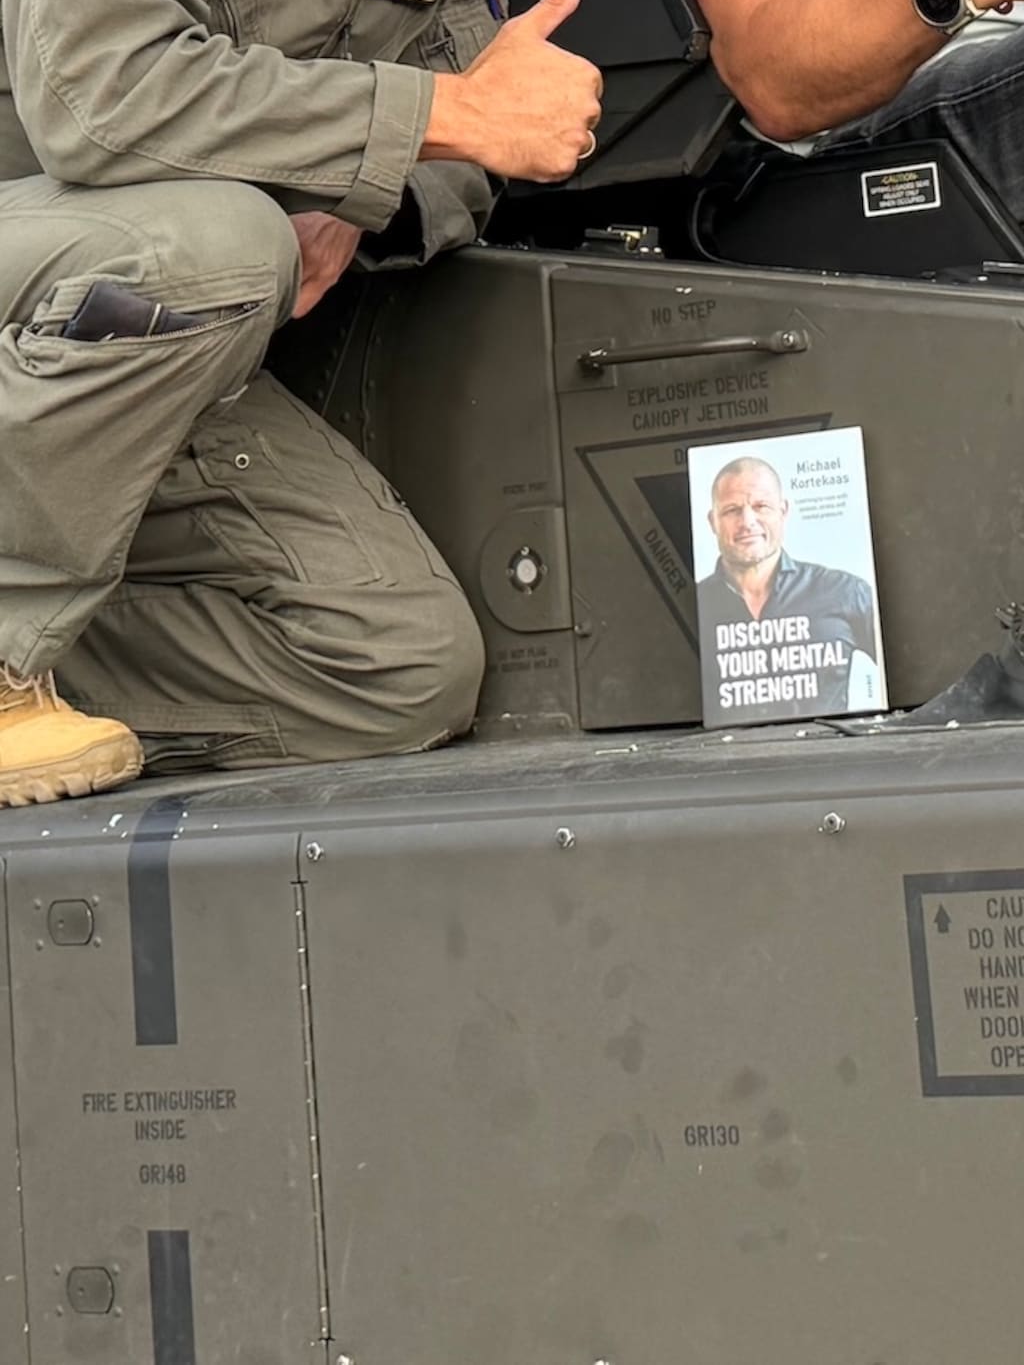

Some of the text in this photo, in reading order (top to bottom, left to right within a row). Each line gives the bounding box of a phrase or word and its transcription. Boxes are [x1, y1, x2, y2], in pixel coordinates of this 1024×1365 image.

[651, 299, 716, 325] NO STEP
[627, 371, 769, 407] EXPLOSIVE DEVICE
[633, 397, 768, 431] CANOPY JETTISON
[797, 457, 841, 474] Michael
[790, 474, 849, 490] Kortekaas
[645, 529, 687, 595] DANGER
[716, 616, 810, 650] DISCOVER
[716, 640, 849, 679] YOUR MENTAL
[719, 672, 818, 708] STRENGTH
[968, 928, 994, 950] DO
[964, 986, 1019, 1010] WHEN
[82, 1089, 237, 1113] FIRE EXTINGUISHER
[135, 1119, 186, 1140] INSIDE
